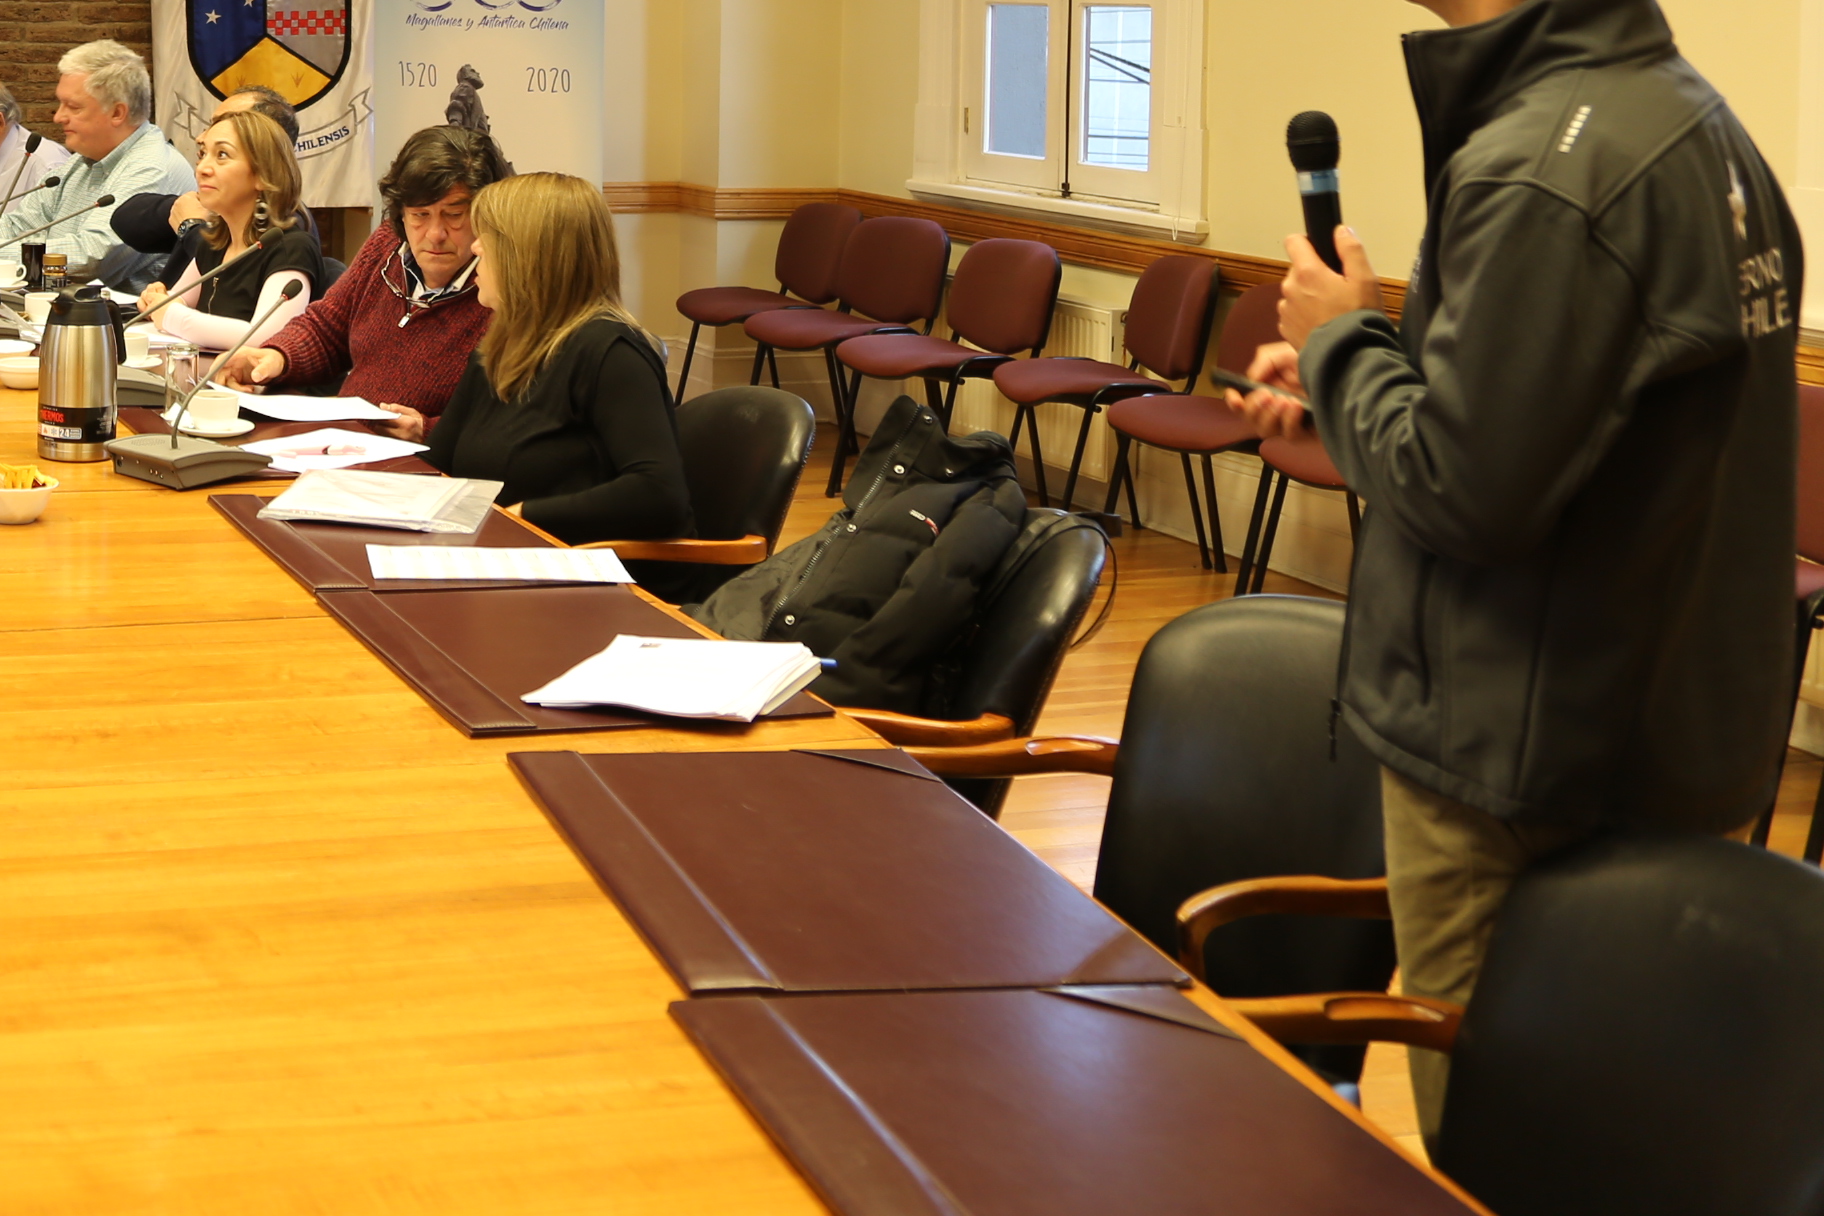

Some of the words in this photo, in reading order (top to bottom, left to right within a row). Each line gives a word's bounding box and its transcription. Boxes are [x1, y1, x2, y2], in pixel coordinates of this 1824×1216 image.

[405, 13, 462, 31] Magallanes
[464, 18, 474, 31] y
[529, 17, 569, 31] Chilena
[398, 61, 437, 87] 1520
[526, 67, 571, 93] 2020
[294, 126, 350, 152] HILENSIS
